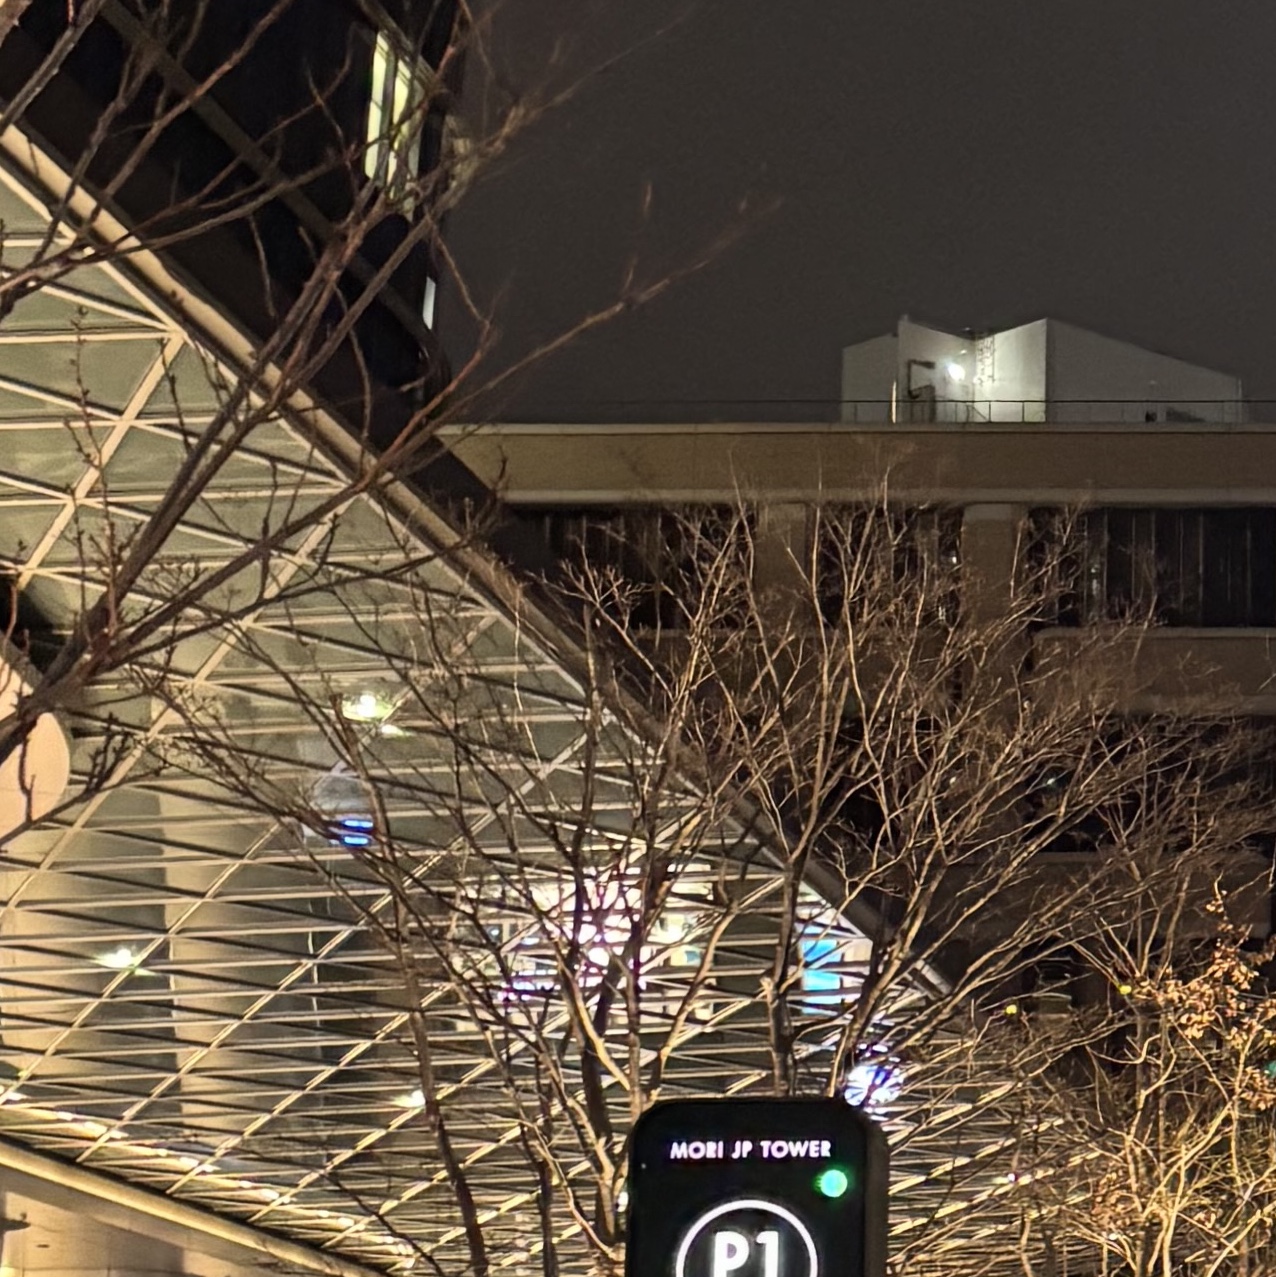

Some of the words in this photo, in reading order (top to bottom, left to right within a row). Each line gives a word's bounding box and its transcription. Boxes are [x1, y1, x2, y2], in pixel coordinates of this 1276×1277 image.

[670, 1141, 724, 1159] MORI
[731, 1140, 753, 1159] JP
[760, 1140, 831, 1159] TOWER
